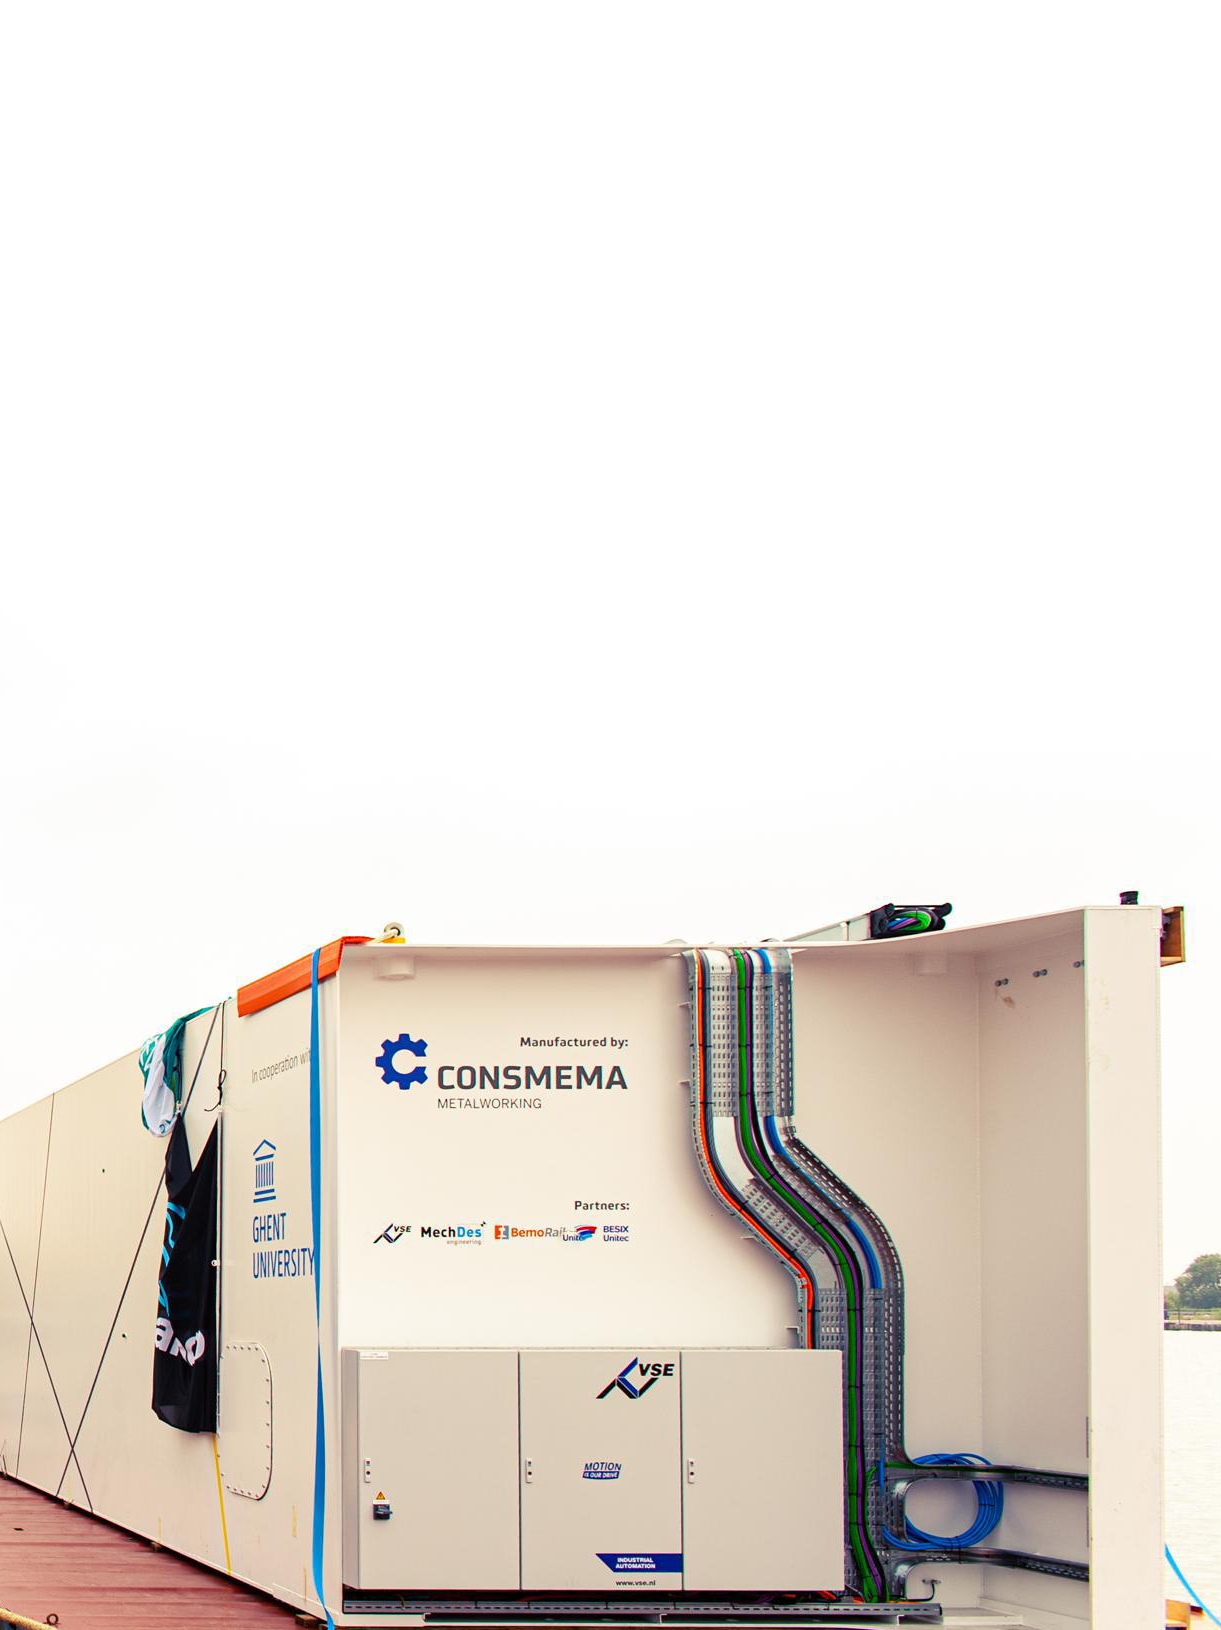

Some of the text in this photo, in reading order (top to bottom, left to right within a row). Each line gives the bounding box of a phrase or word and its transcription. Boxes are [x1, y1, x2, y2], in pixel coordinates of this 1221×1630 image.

[520, 1036, 629, 1050] Manufactured by:
[259, 1053, 298, 1080] cooperation
[437, 1065, 628, 1090] CONSMEMA
[437, 1098, 542, 1109] METALWORKING
[574, 1200, 630, 1211] Partners:
[252, 1212, 287, 1244] GHENT
[393, 1225, 412, 1233] VSE
[420, 1226, 482, 1238] MechDes
[602, 1225, 629, 1233] BESIX
[602, 1234, 629, 1242] Unitec
[252, 1247, 315, 1279] UNIVERSITY
[638, 1363, 675, 1377] VSE
[584, 1461, 622, 1471] MOTION
